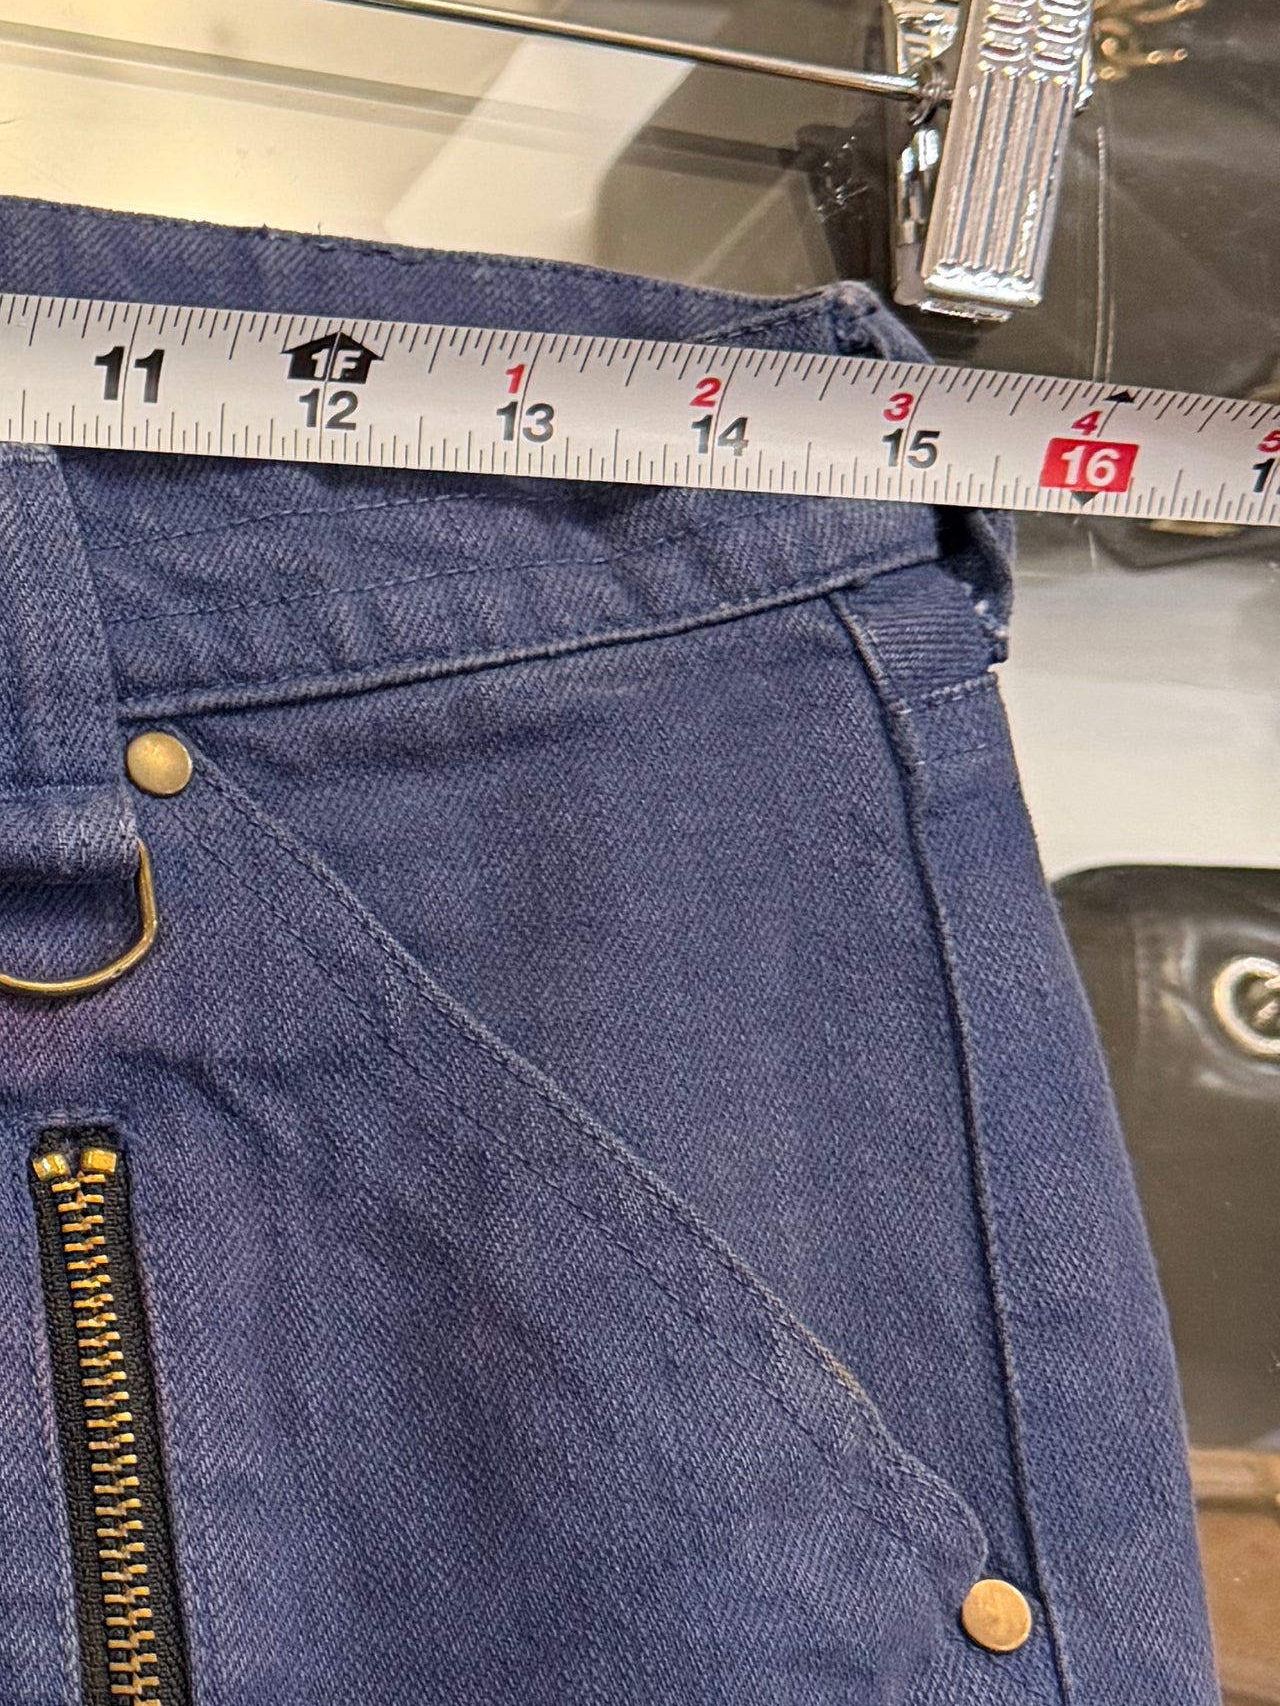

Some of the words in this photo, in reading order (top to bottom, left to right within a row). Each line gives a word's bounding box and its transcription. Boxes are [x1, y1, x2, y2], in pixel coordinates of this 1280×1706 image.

[93, 345, 166, 405] 11
[310, 347, 362, 380] 1F
[505, 363, 526, 394] 1
[299, 387, 358, 431] 12
[689, 376, 722, 408] 2
[883, 392, 915, 422] 3
[496, 400, 556, 443] 13
[690, 413, 750, 457] 14
[1071, 410, 1103, 437] 4
[881, 428, 941, 469] 15
[1060, 443, 1122, 488] 16
[1251, 458, 1280, 495] 1
